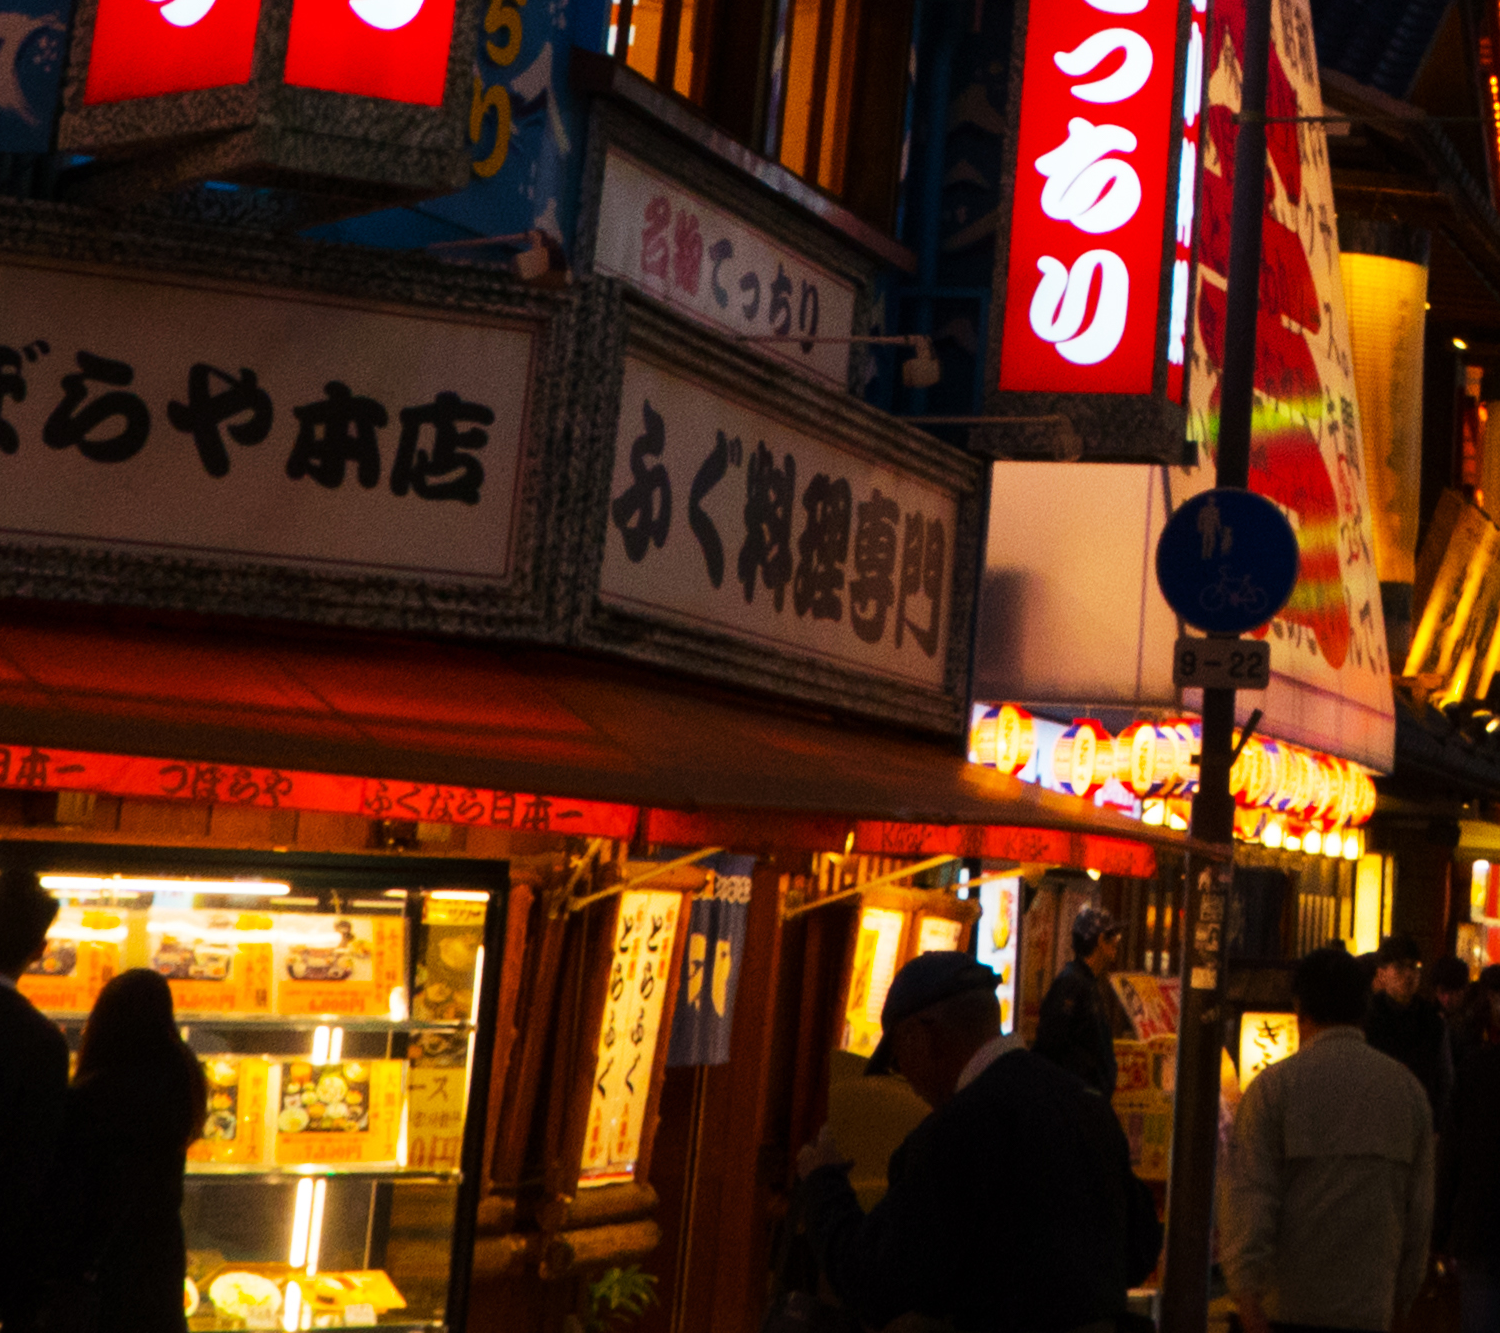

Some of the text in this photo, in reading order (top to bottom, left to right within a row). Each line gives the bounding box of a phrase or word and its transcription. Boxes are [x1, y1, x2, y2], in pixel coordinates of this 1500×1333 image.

[612, 397, 946, 659] ふぐ料理専門
